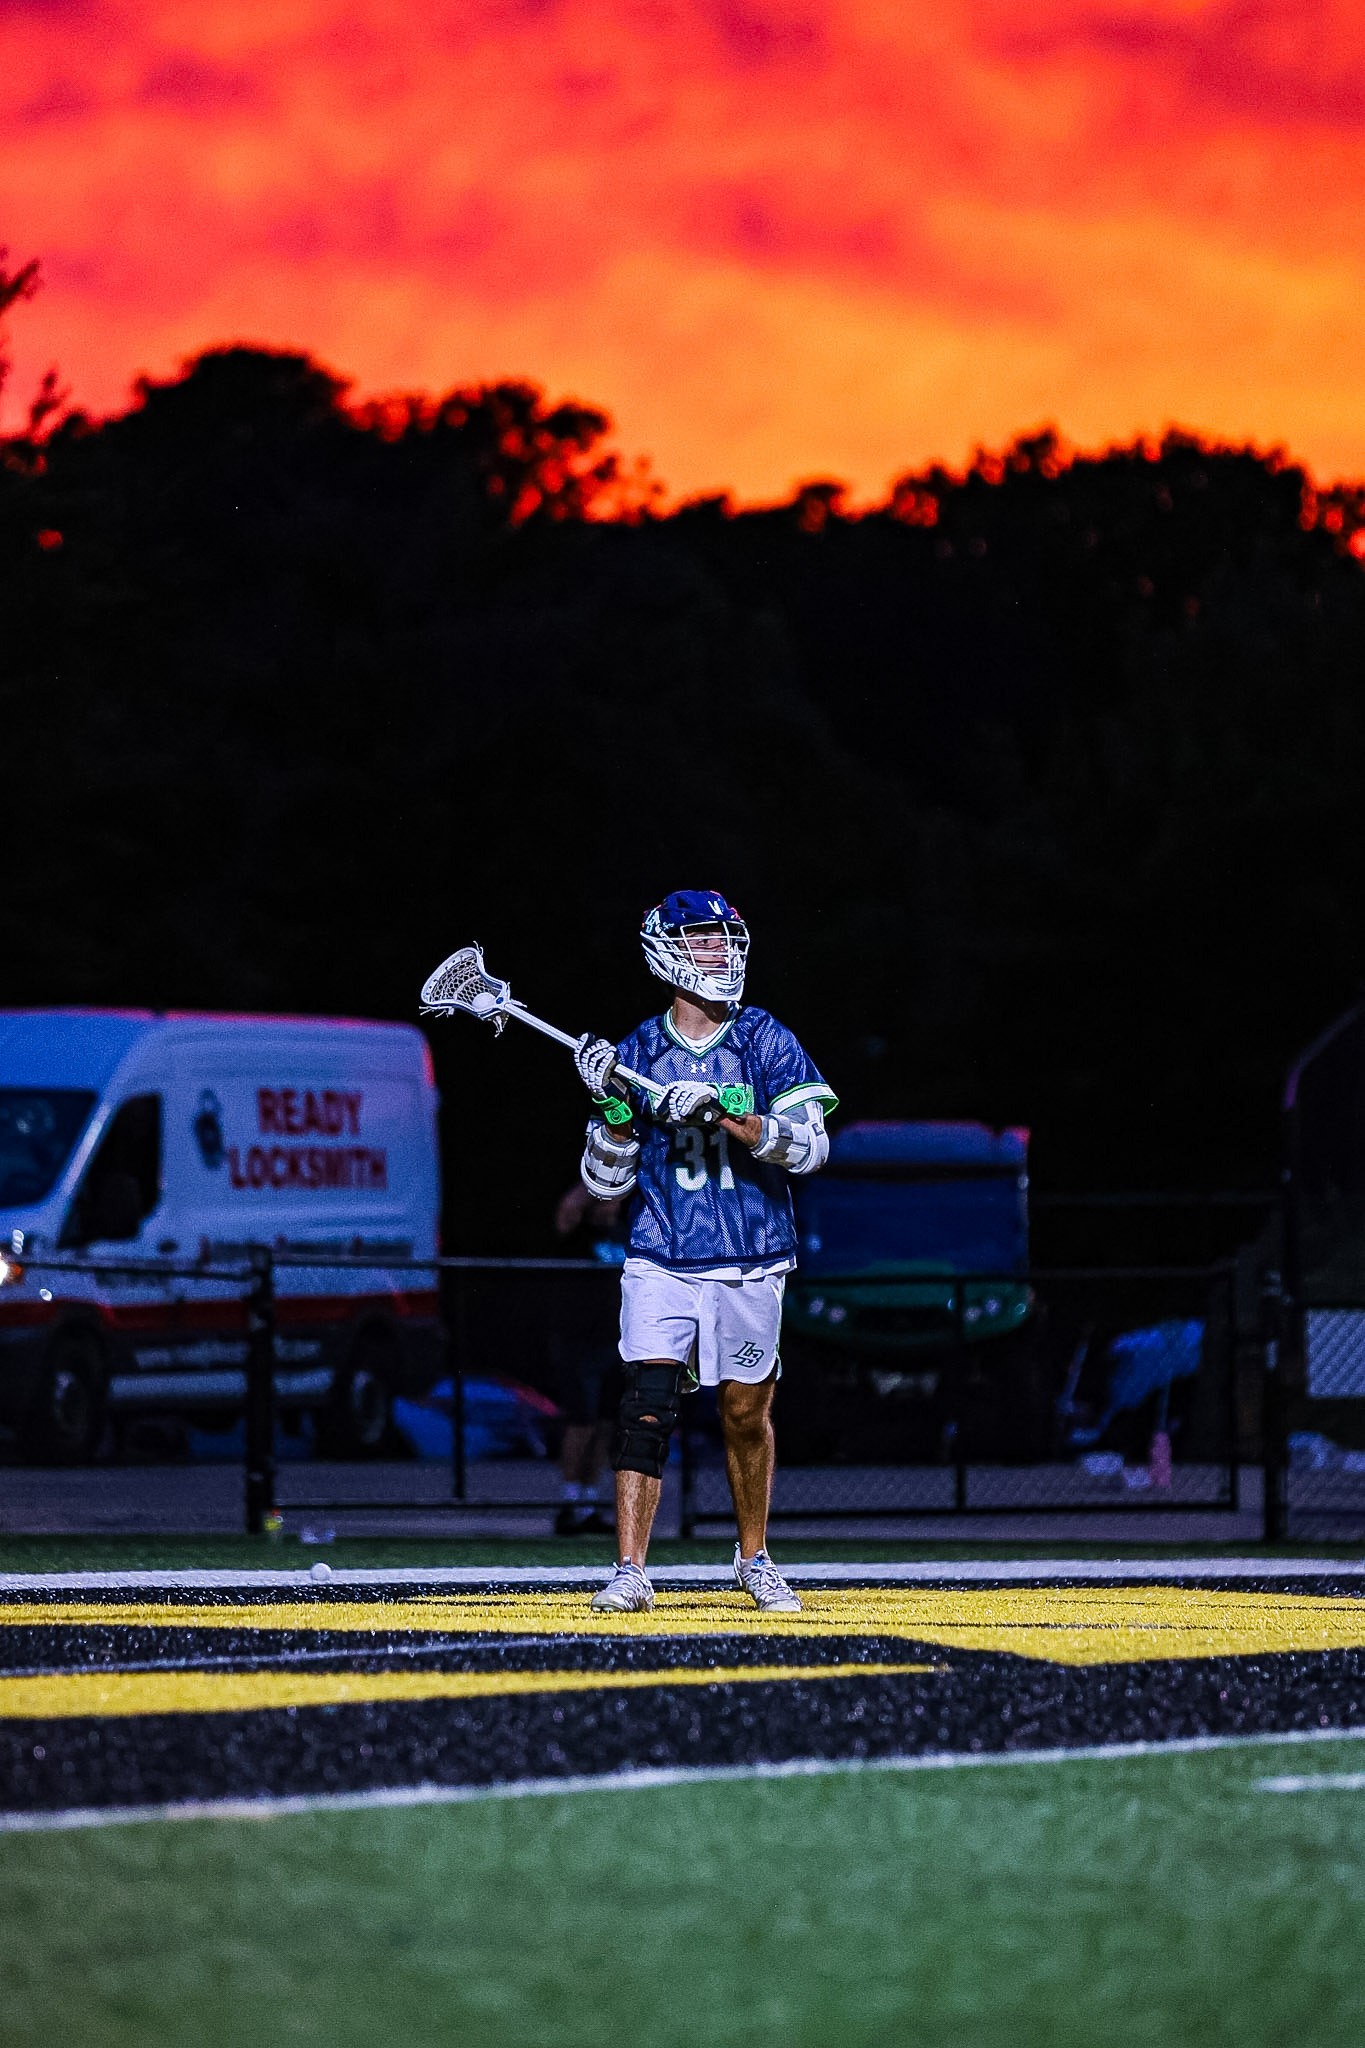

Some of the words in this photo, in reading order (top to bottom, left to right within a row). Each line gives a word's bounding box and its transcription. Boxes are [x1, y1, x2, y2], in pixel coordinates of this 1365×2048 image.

[258, 1088, 363, 1136] READY
[229, 1146, 388, 1190] LOCKSMITH
[675, 1126, 736, 1192] 31
